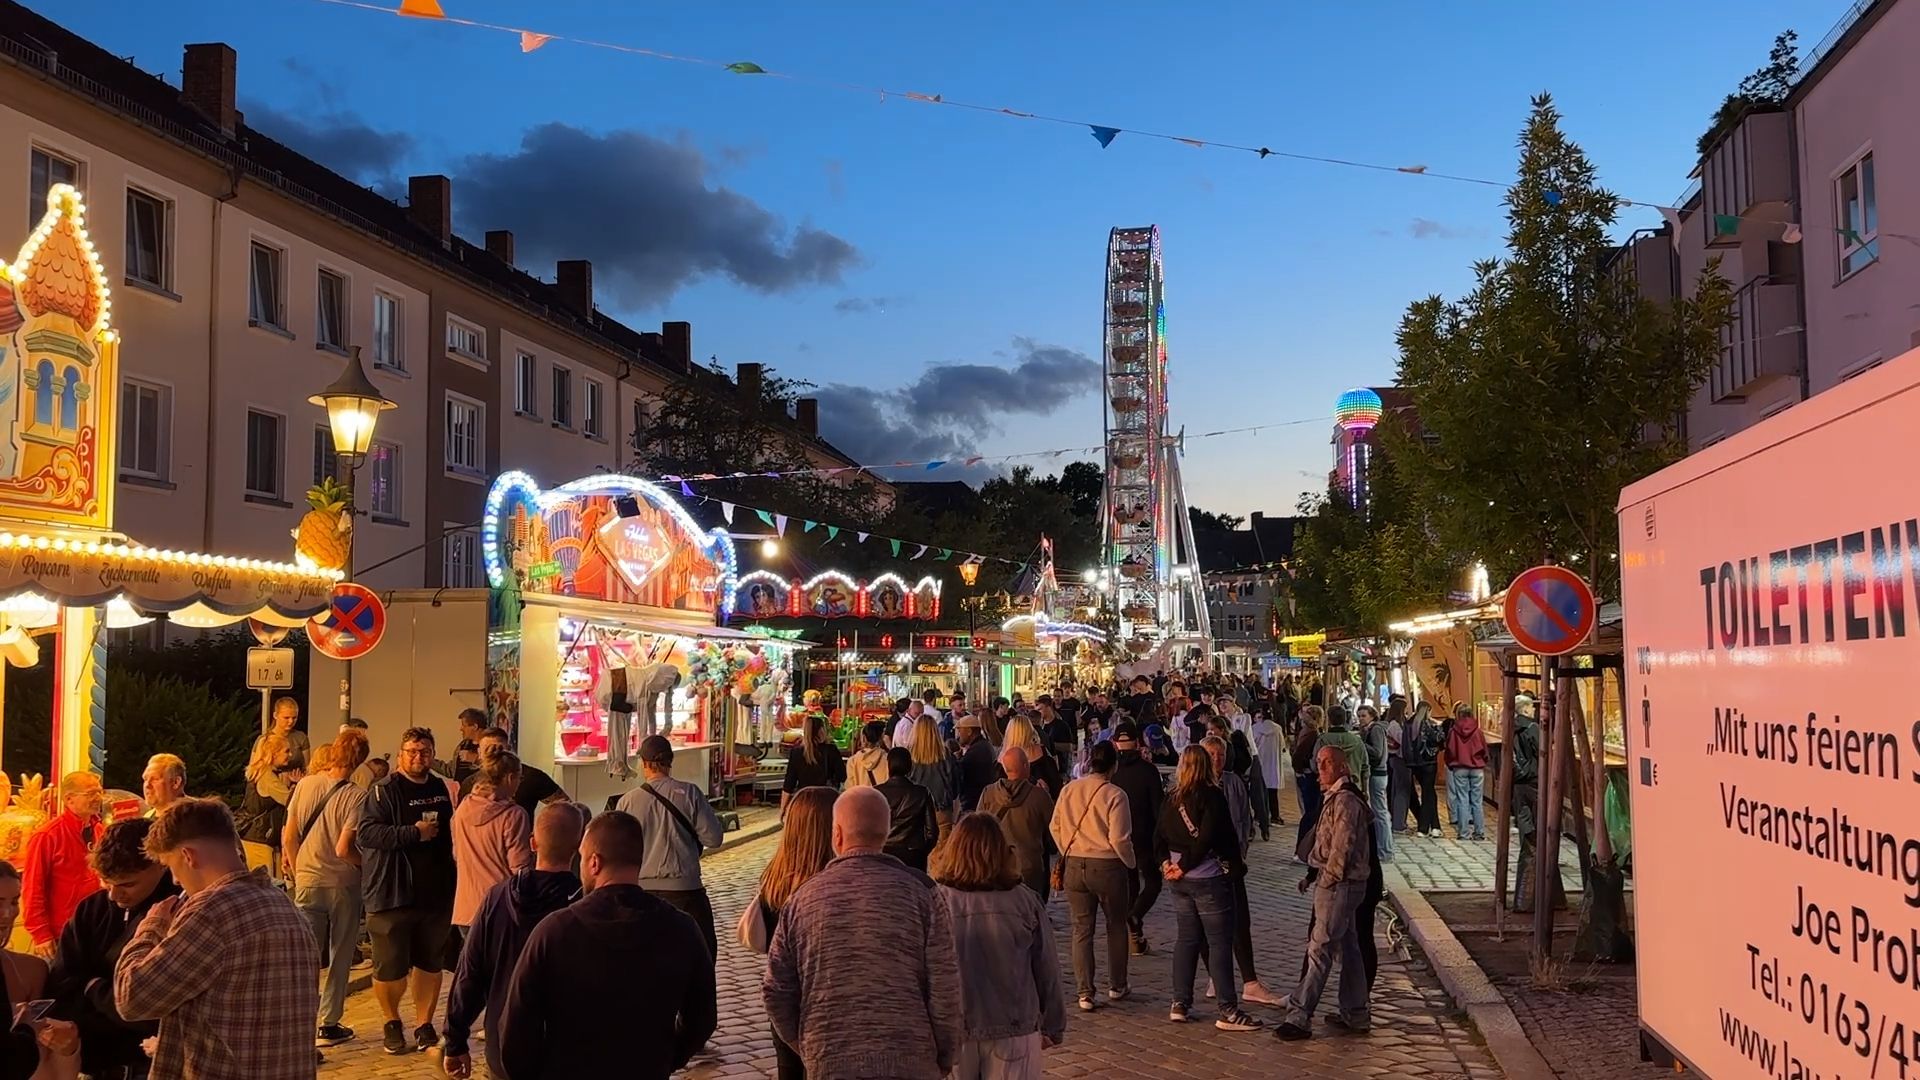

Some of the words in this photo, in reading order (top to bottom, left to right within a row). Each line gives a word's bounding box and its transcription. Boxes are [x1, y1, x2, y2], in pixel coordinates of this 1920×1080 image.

[21, 554, 71, 581] Popcorn
[98, 561, 161, 588] Zuckerwatte
[191, 568, 232, 597] Waffeln
[1700, 518, 1920, 650] TOILETTEN
[1637, 646, 1651, 675] WC
[1754, 721, 1798, 764] uns
[1806, 712, 1899, 780] feiern
[1791, 886, 1841, 954] Joe
[1746, 943, 1793, 1012] Tel.:
